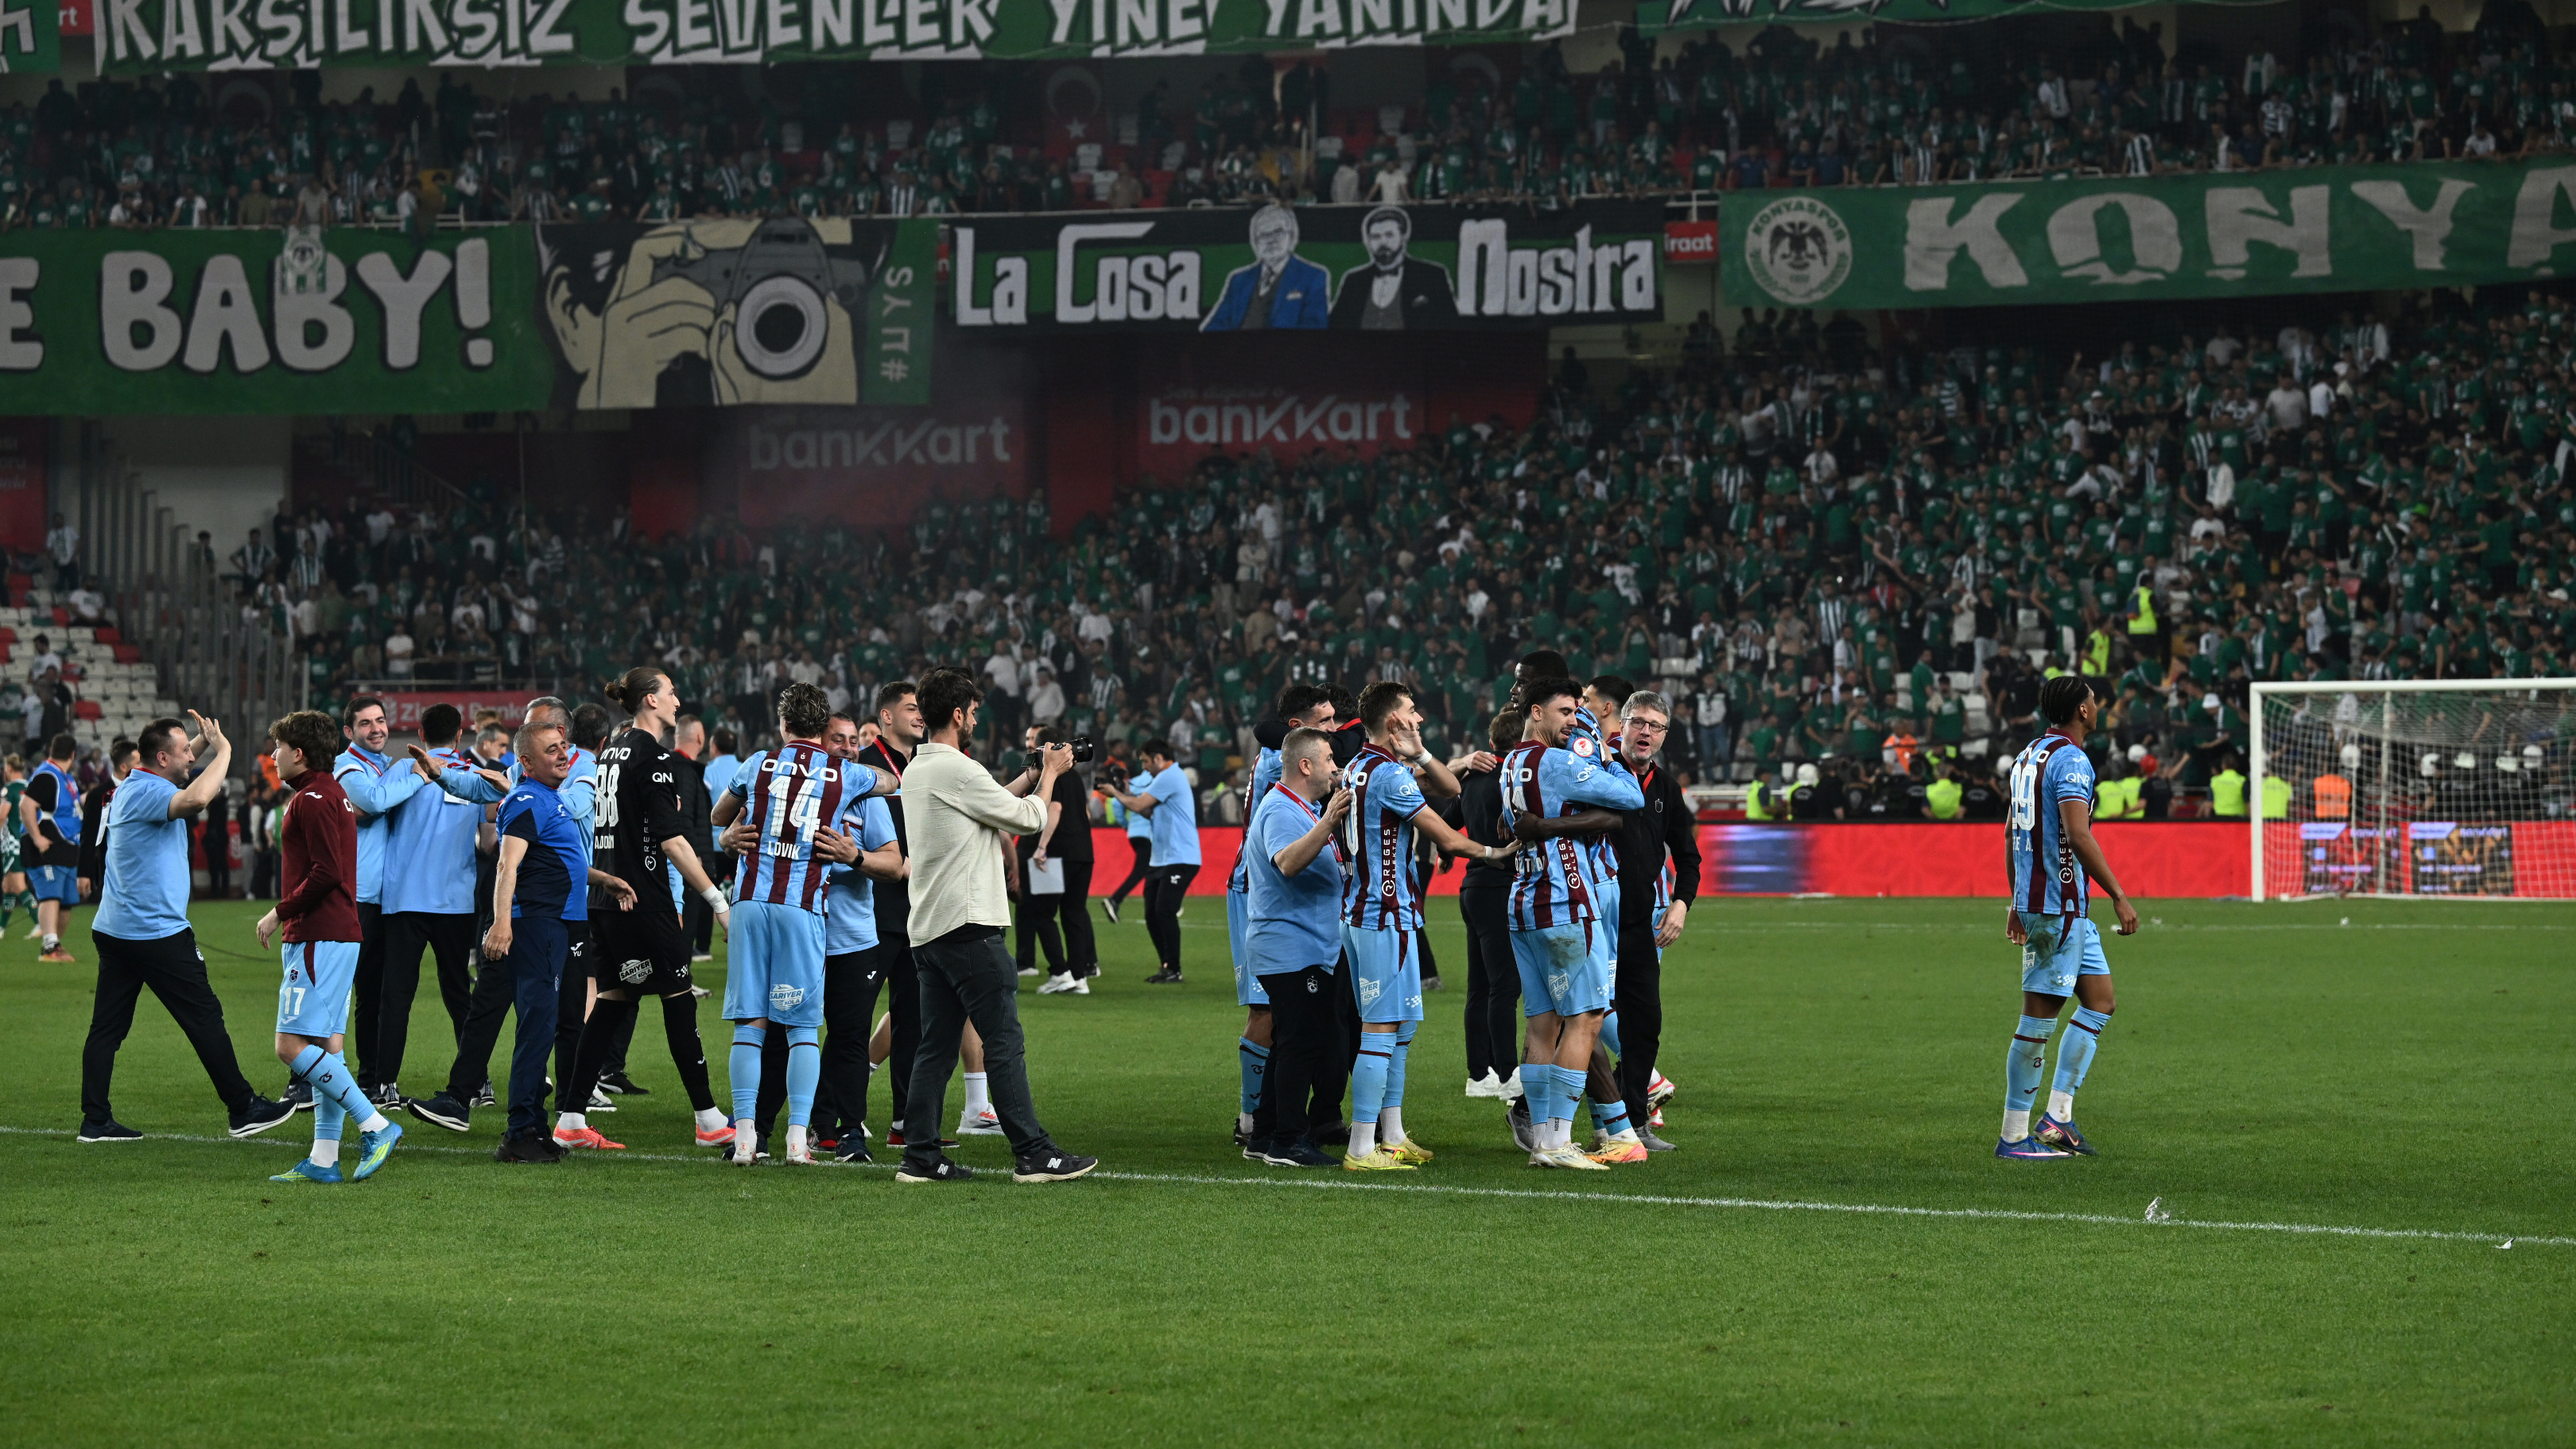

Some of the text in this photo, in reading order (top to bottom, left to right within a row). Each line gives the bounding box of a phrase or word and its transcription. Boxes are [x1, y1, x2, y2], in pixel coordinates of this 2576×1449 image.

[956, 227, 1027, 325] La
[1056, 222, 1201, 323] Cosa
[101, 238, 494, 371] BABY!
[652, 772, 674, 783] QN
[762, 759, 838, 783] onvo
[595, 763, 620, 827] 88
[1399, 781, 1420, 795] QN
[767, 775, 821, 843] 14
[620, 960, 650, 980] SARIYER
[638, 969, 652, 979] KOLA
[284, 987, 306, 1015] 17
[770, 990, 802, 1000] SARIYER
